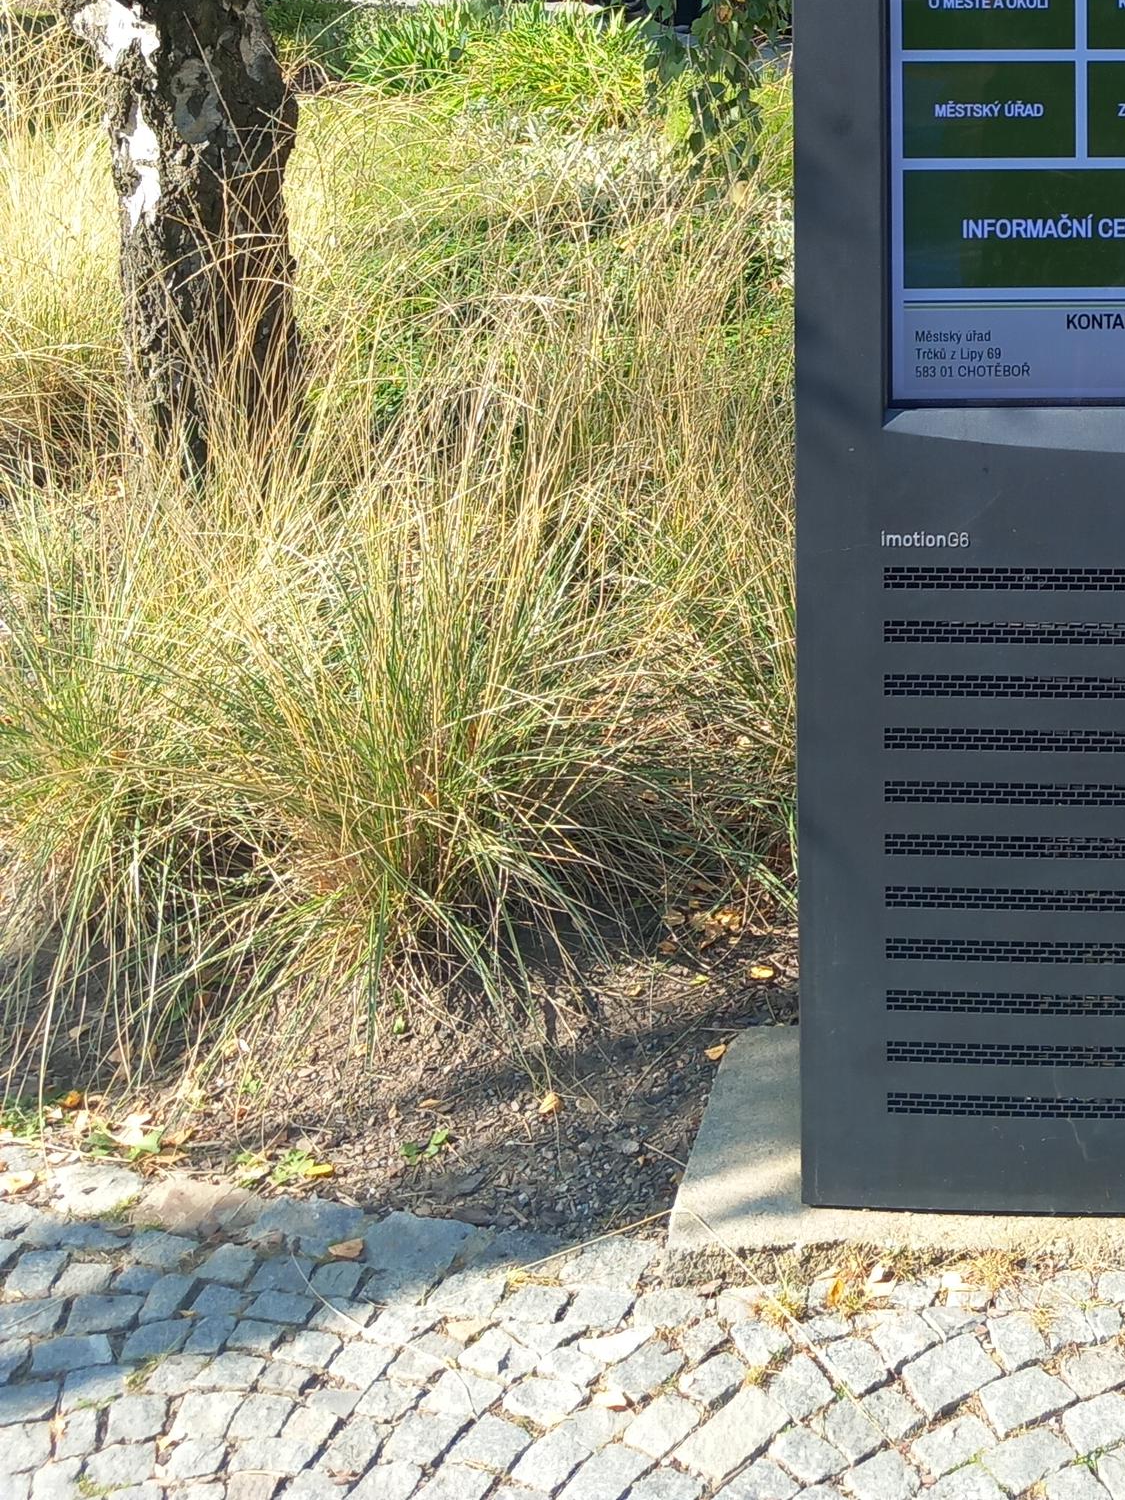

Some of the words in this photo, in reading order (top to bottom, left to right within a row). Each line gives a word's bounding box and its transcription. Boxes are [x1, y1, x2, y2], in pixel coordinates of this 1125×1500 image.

[935, 101, 1000, 118] MĚSTSKÝ
[1004, 100, 1044, 118] ÚŘAD
[962, 214, 1094, 239] INFORMAČNÍ
[915, 330, 962, 344] Městský
[965, 330, 992, 342] úřad
[915, 348, 947, 360] Trčků
[950, 351, 956, 360] z
[960, 348, 984, 362] Lipy
[987, 348, 1001, 360] 69
[915, 366, 937, 378] 583
[940, 366, 954, 378] 01
[958, 362, 1031, 378] CHOTĚBOŘ
[881, 529, 969, 548] imotionG6
